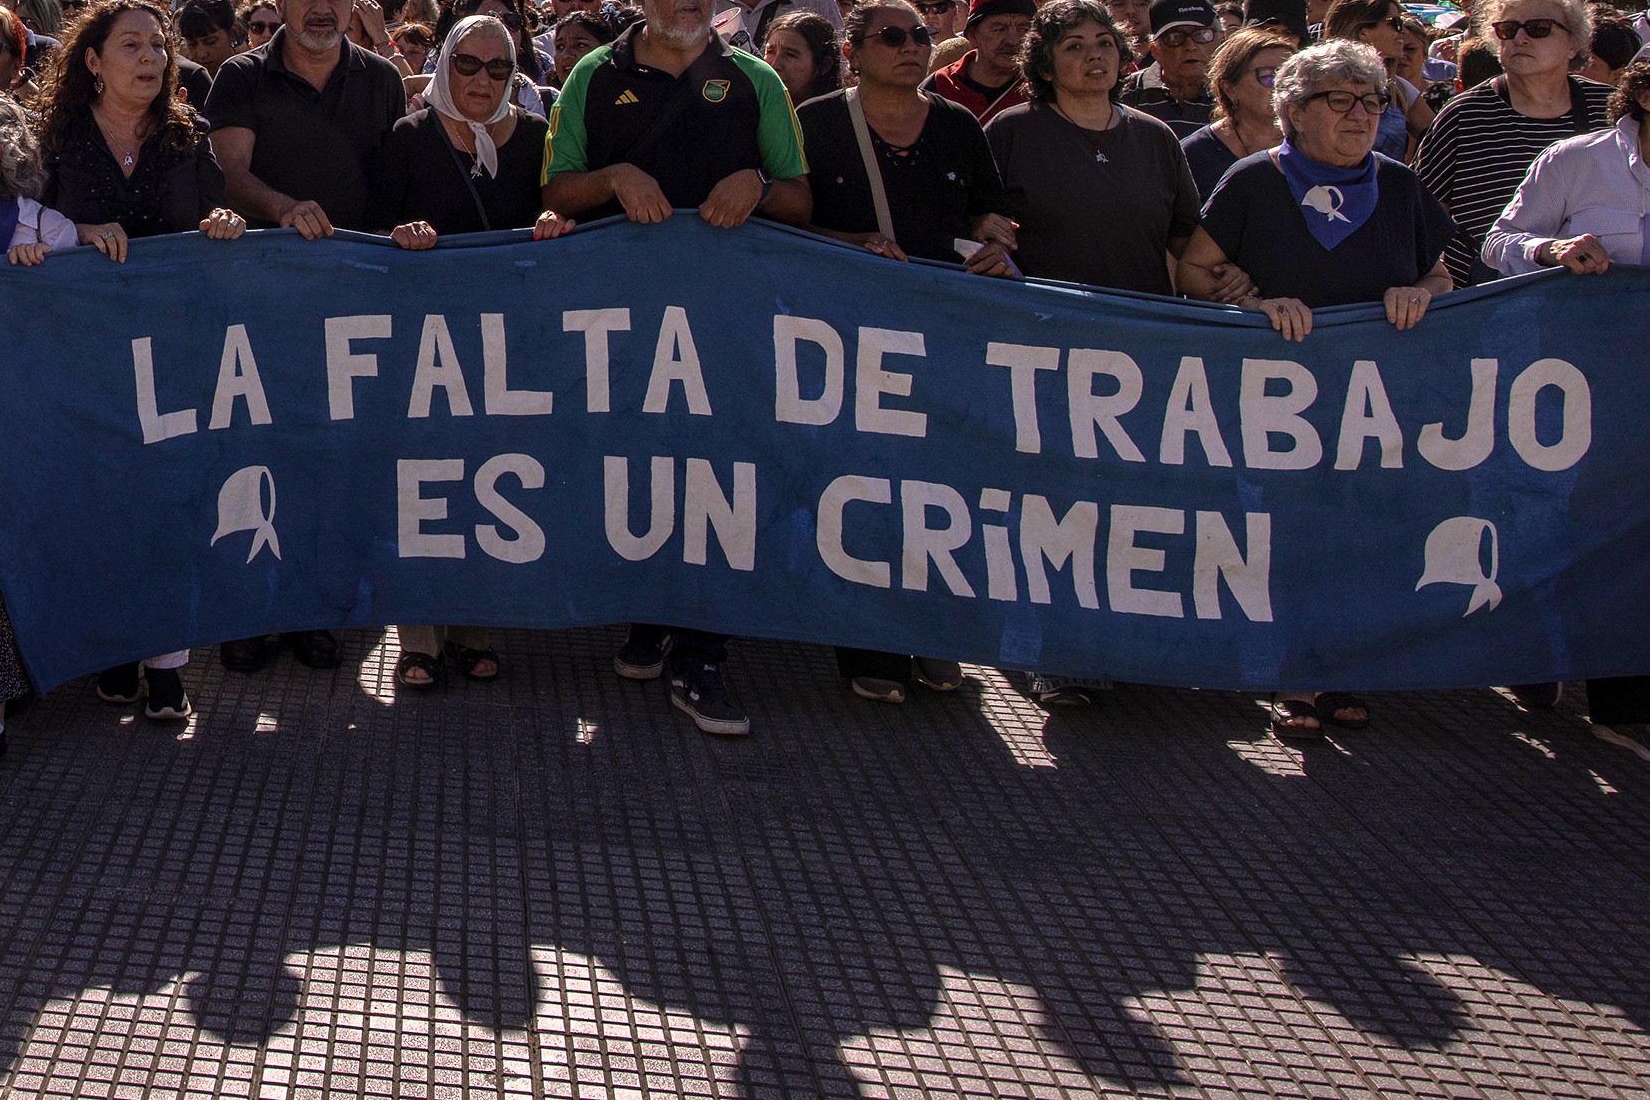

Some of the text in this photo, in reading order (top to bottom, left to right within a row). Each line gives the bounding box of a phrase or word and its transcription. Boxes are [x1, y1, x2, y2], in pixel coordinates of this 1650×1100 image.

[132, 306, 1592, 472] LA FALTA DE TRABAJO
[396, 453, 546, 565] ES
[604, 456, 756, 572] UN
